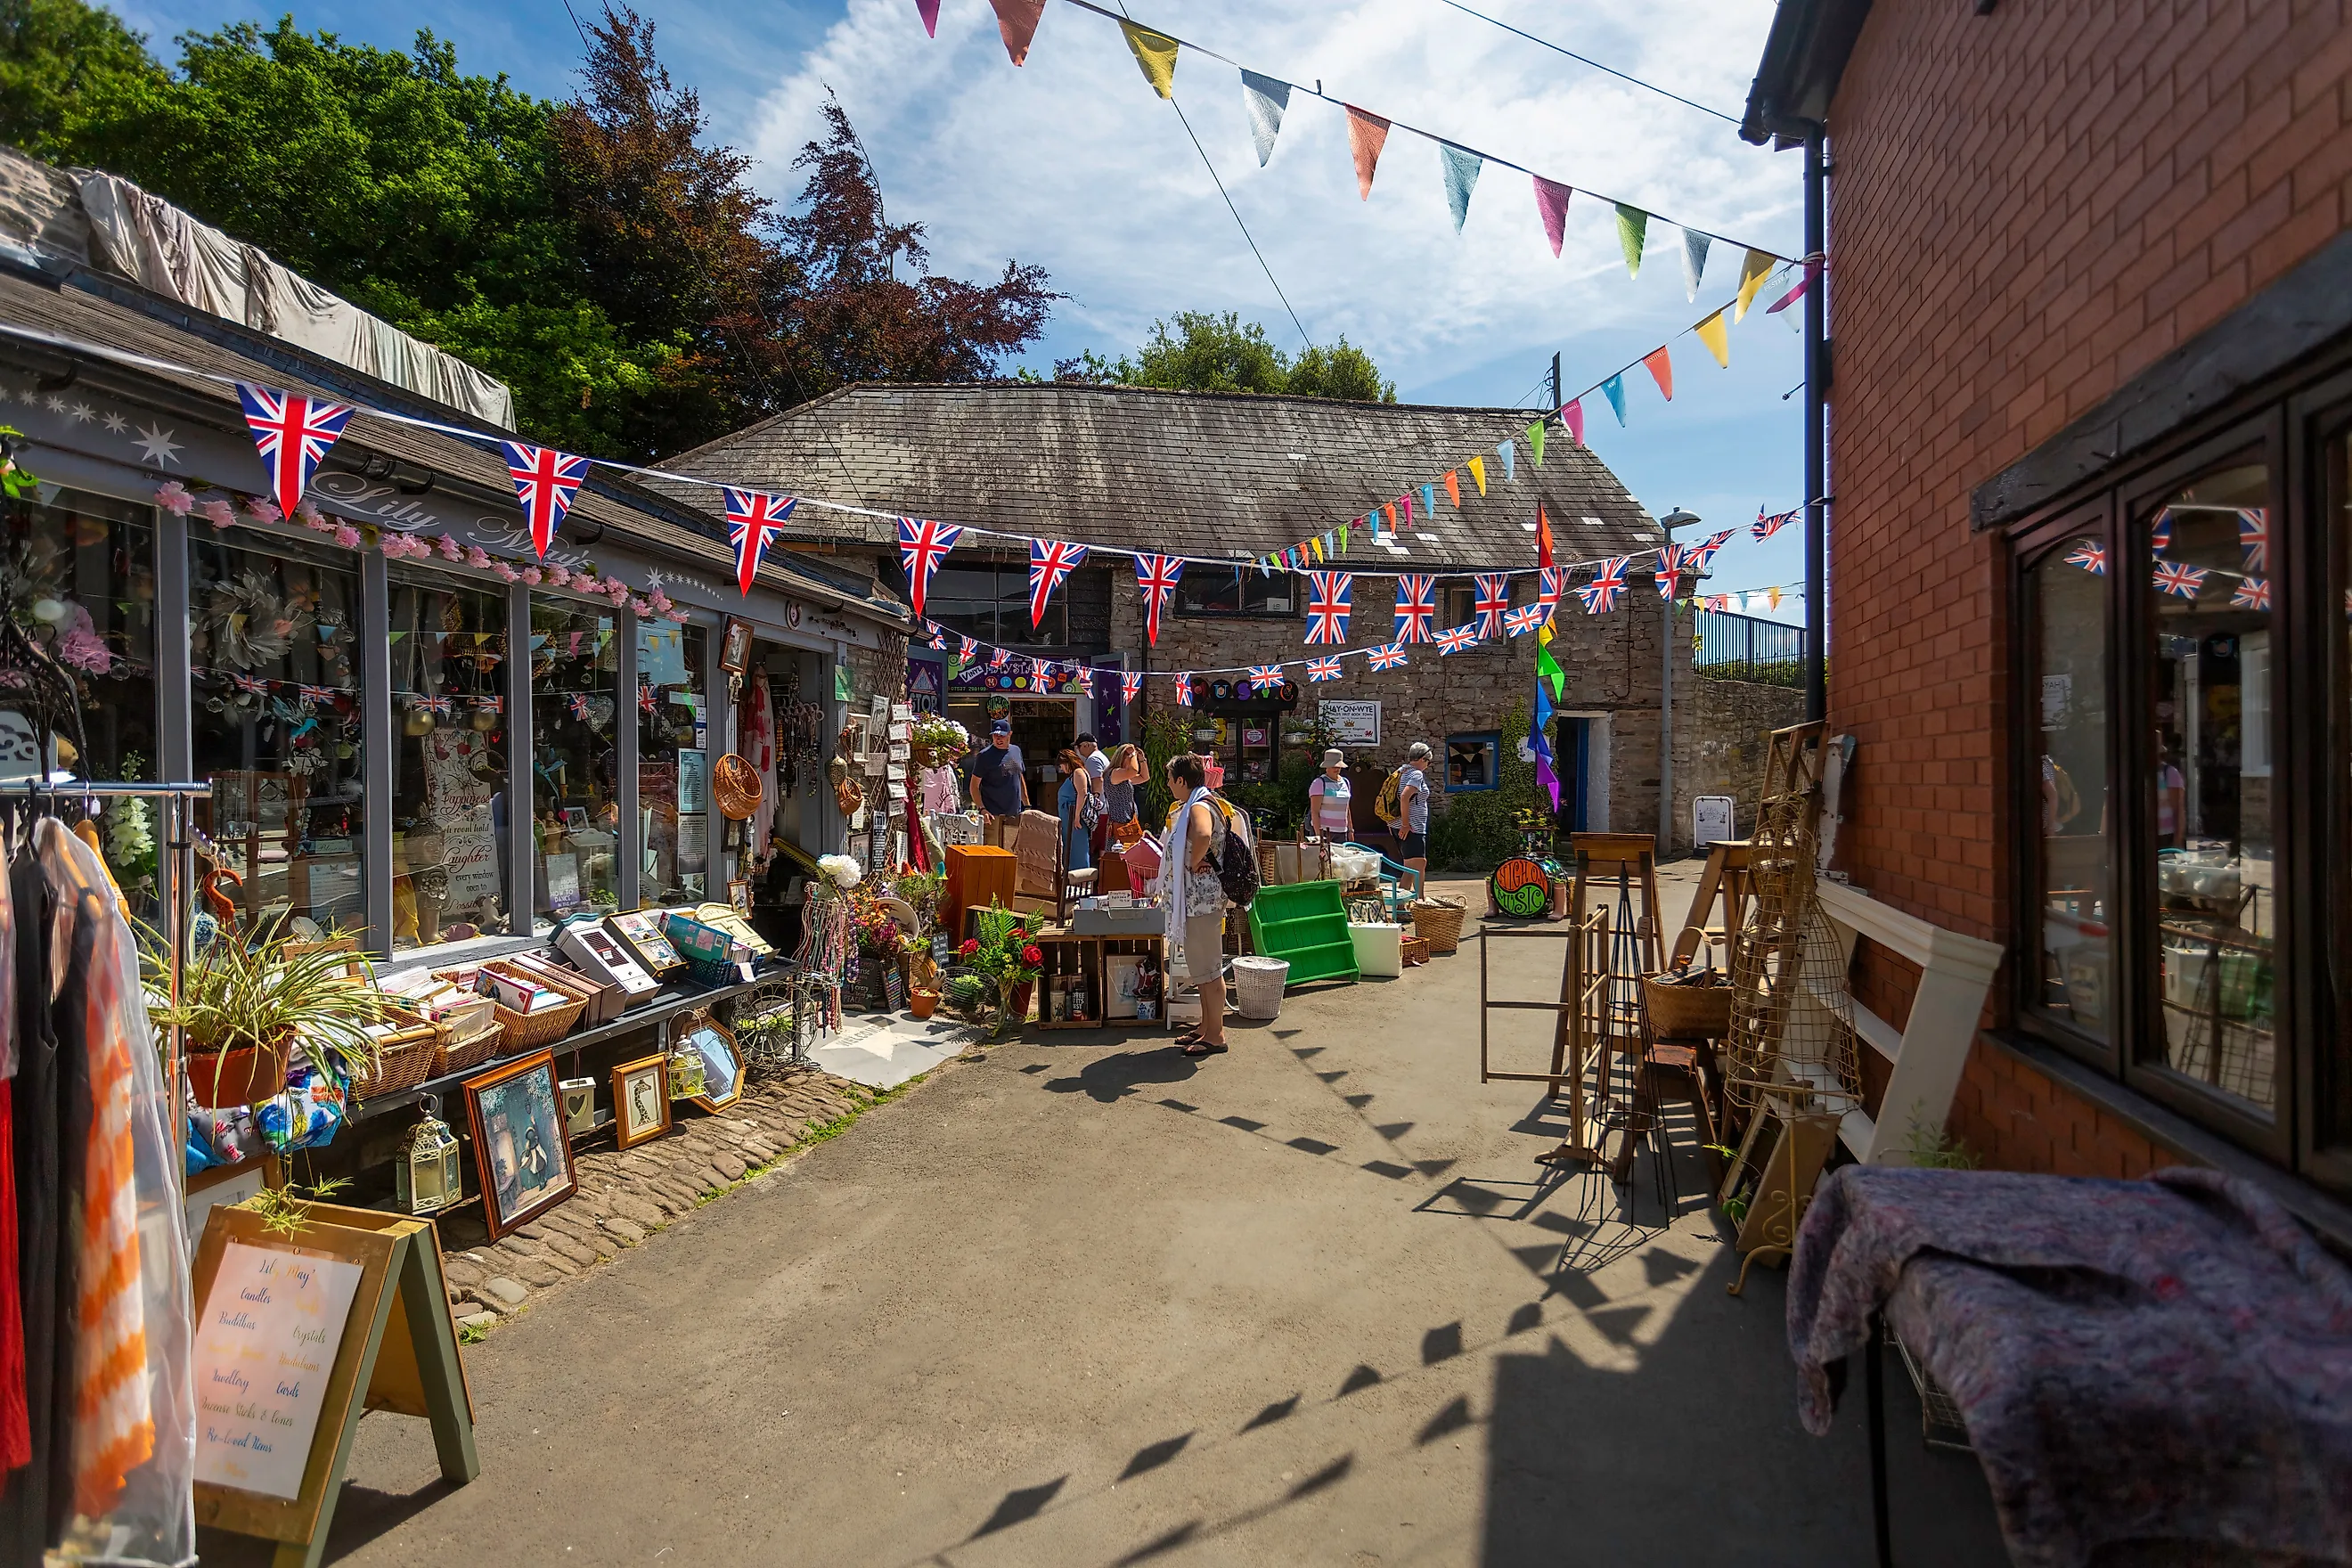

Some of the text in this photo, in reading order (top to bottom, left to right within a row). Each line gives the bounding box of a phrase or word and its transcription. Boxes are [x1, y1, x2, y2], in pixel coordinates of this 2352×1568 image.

[303, 471, 440, 531] Lily
[962, 667, 982, 682] VINYL
[984, 662, 1057, 675] HAYSTAS
[910, 693, 937, 712] STOP
[474, 824, 489, 832] hold
[455, 870, 494, 883] every window
[466, 886, 479, 895] open
[1495, 885, 1542, 914] MUSIC
[837, 1025, 885, 1046] WELCOME
[259, 1258, 279, 1282] Lily
[241, 1287, 272, 1304] Candles
[218, 1311, 257, 1330] Buddhas
[293, 1325, 325, 1347] Crystals
[276, 1381, 300, 1398] Cards
[201, 1396, 231, 1415] Incense
[236, 1402, 256, 1419] Sticks
[271, 1409, 293, 1427] Cones
[208, 1427, 272, 1453] Pre-loved Items
